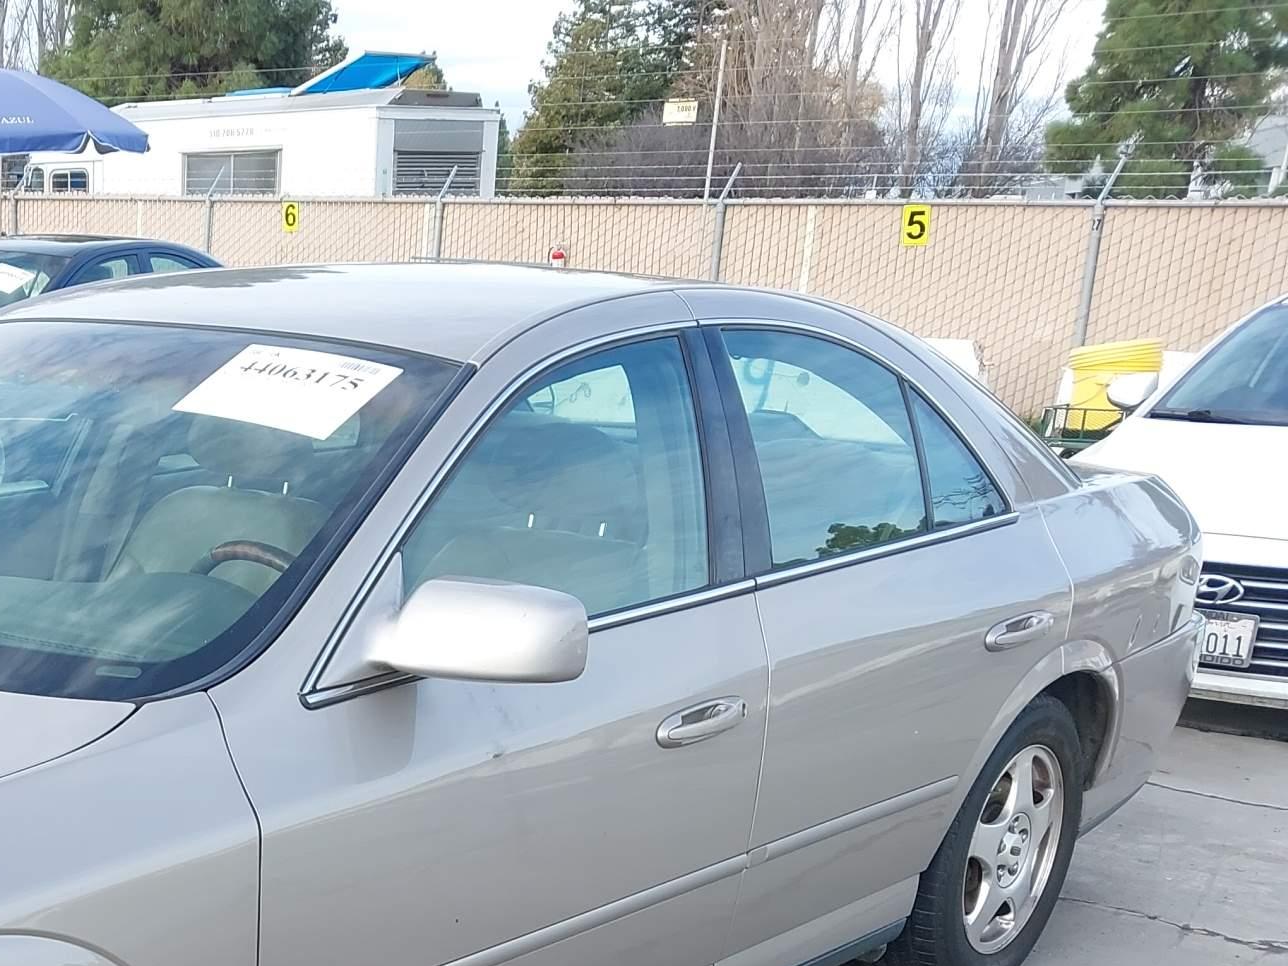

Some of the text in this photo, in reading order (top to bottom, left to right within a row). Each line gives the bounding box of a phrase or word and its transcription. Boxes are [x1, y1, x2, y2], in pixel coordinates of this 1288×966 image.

[285, 203, 296, 227] 6
[906, 210, 926, 240] 5
[240, 361, 365, 390] 44063175
